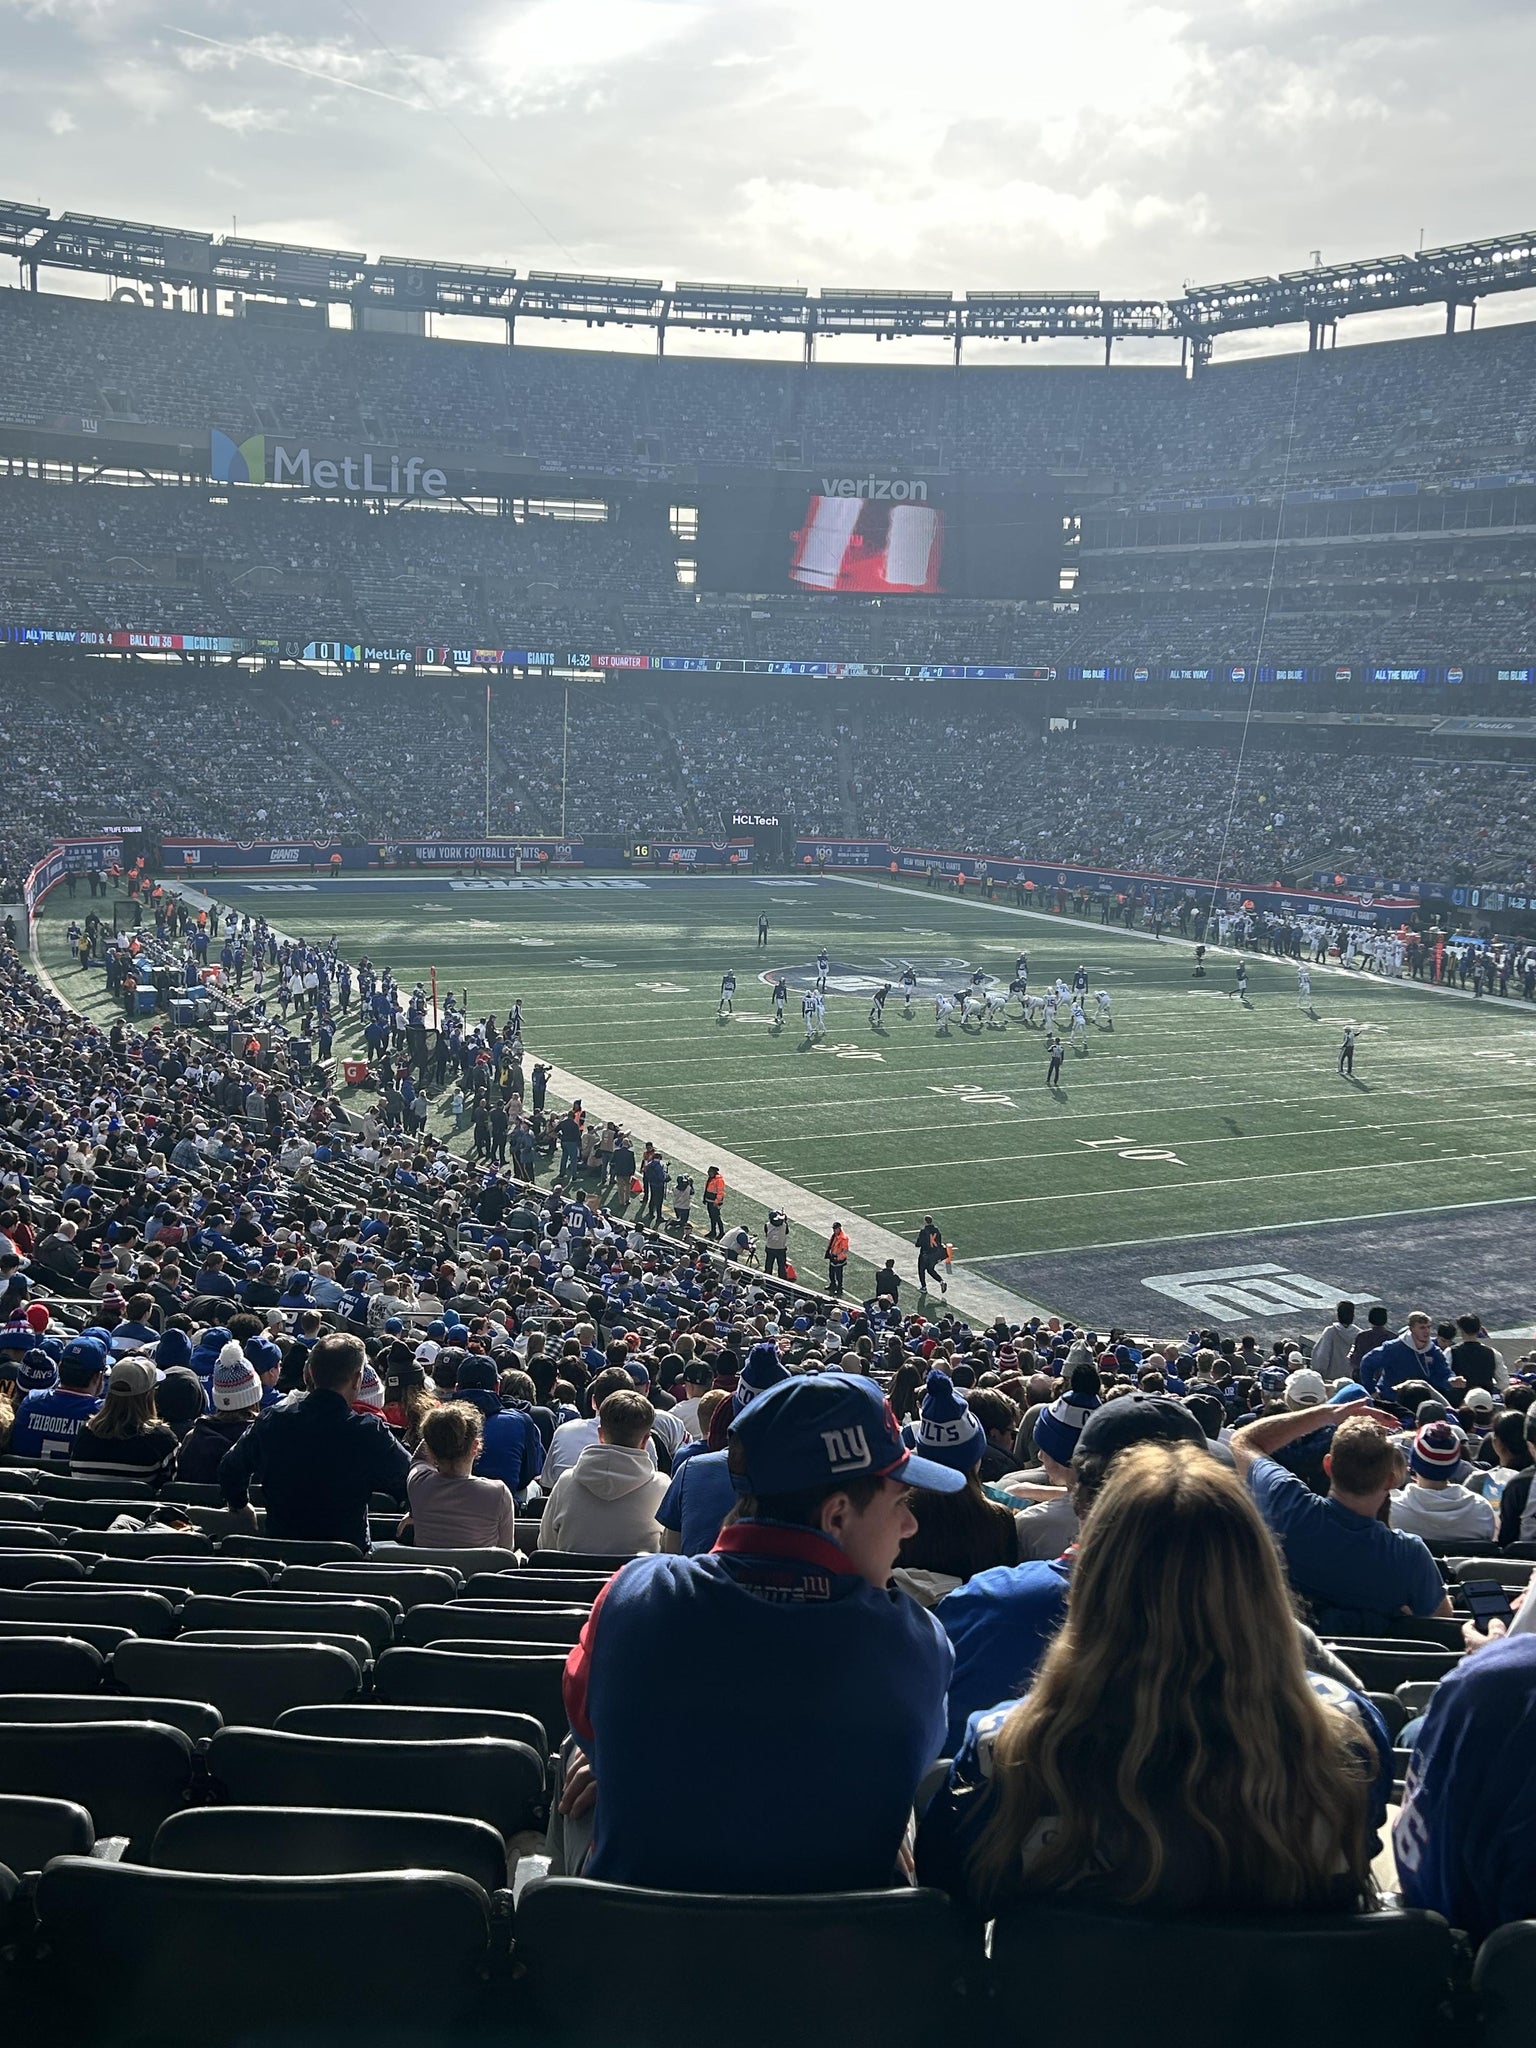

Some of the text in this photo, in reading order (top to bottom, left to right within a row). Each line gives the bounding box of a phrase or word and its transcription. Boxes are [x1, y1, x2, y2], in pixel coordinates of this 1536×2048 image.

[273, 446, 448, 496] MetLife
[821, 473, 928, 500] verizon
[26, 630, 76, 641] ALL THE WAY
[80, 632, 113, 644] 2ND & 4
[129, 634, 148, 647] BALL
[150, 635, 160, 647] ON
[193, 636, 218, 650] COLTS
[320, 642, 328, 659] 0
[364, 648, 412, 661] MetLife
[426, 648, 434, 664] 0
[453, 650, 471, 665] ny
[527, 652, 555, 665] GIANTS
[567, 653, 590, 667] 14:32
[598, 656, 641, 667] 1ST QUARTER
[651, 657, 660, 668] 16
[1083, 669, 1106, 679] BIG BLUE
[1169, 670, 1209, 679] ALL THE WAY
[1276, 670, 1303, 680] BIG BLUE
[1375, 670, 1419, 680] ALL THE WAY
[1498, 671, 1529, 681] BIG BLUE
[732, 815, 779, 826] HCLTech
[103, 848, 120, 858] 100
[269, 849, 300, 862] GIANTS
[416, 847, 437, 859] NEW
[439, 847, 462, 859] YORK
[464, 847, 508, 859] FOOTBALL
[634, 846, 648, 856] 16
[1471, 889, 1479, 906] 0
[347, 1066, 357, 1078] G
[1075, 1135, 1177, 1160] 10
[568, 1211, 584, 1229] 10
[929, 1232, 939, 1249] K
[820, 1424, 872, 1474] ny
